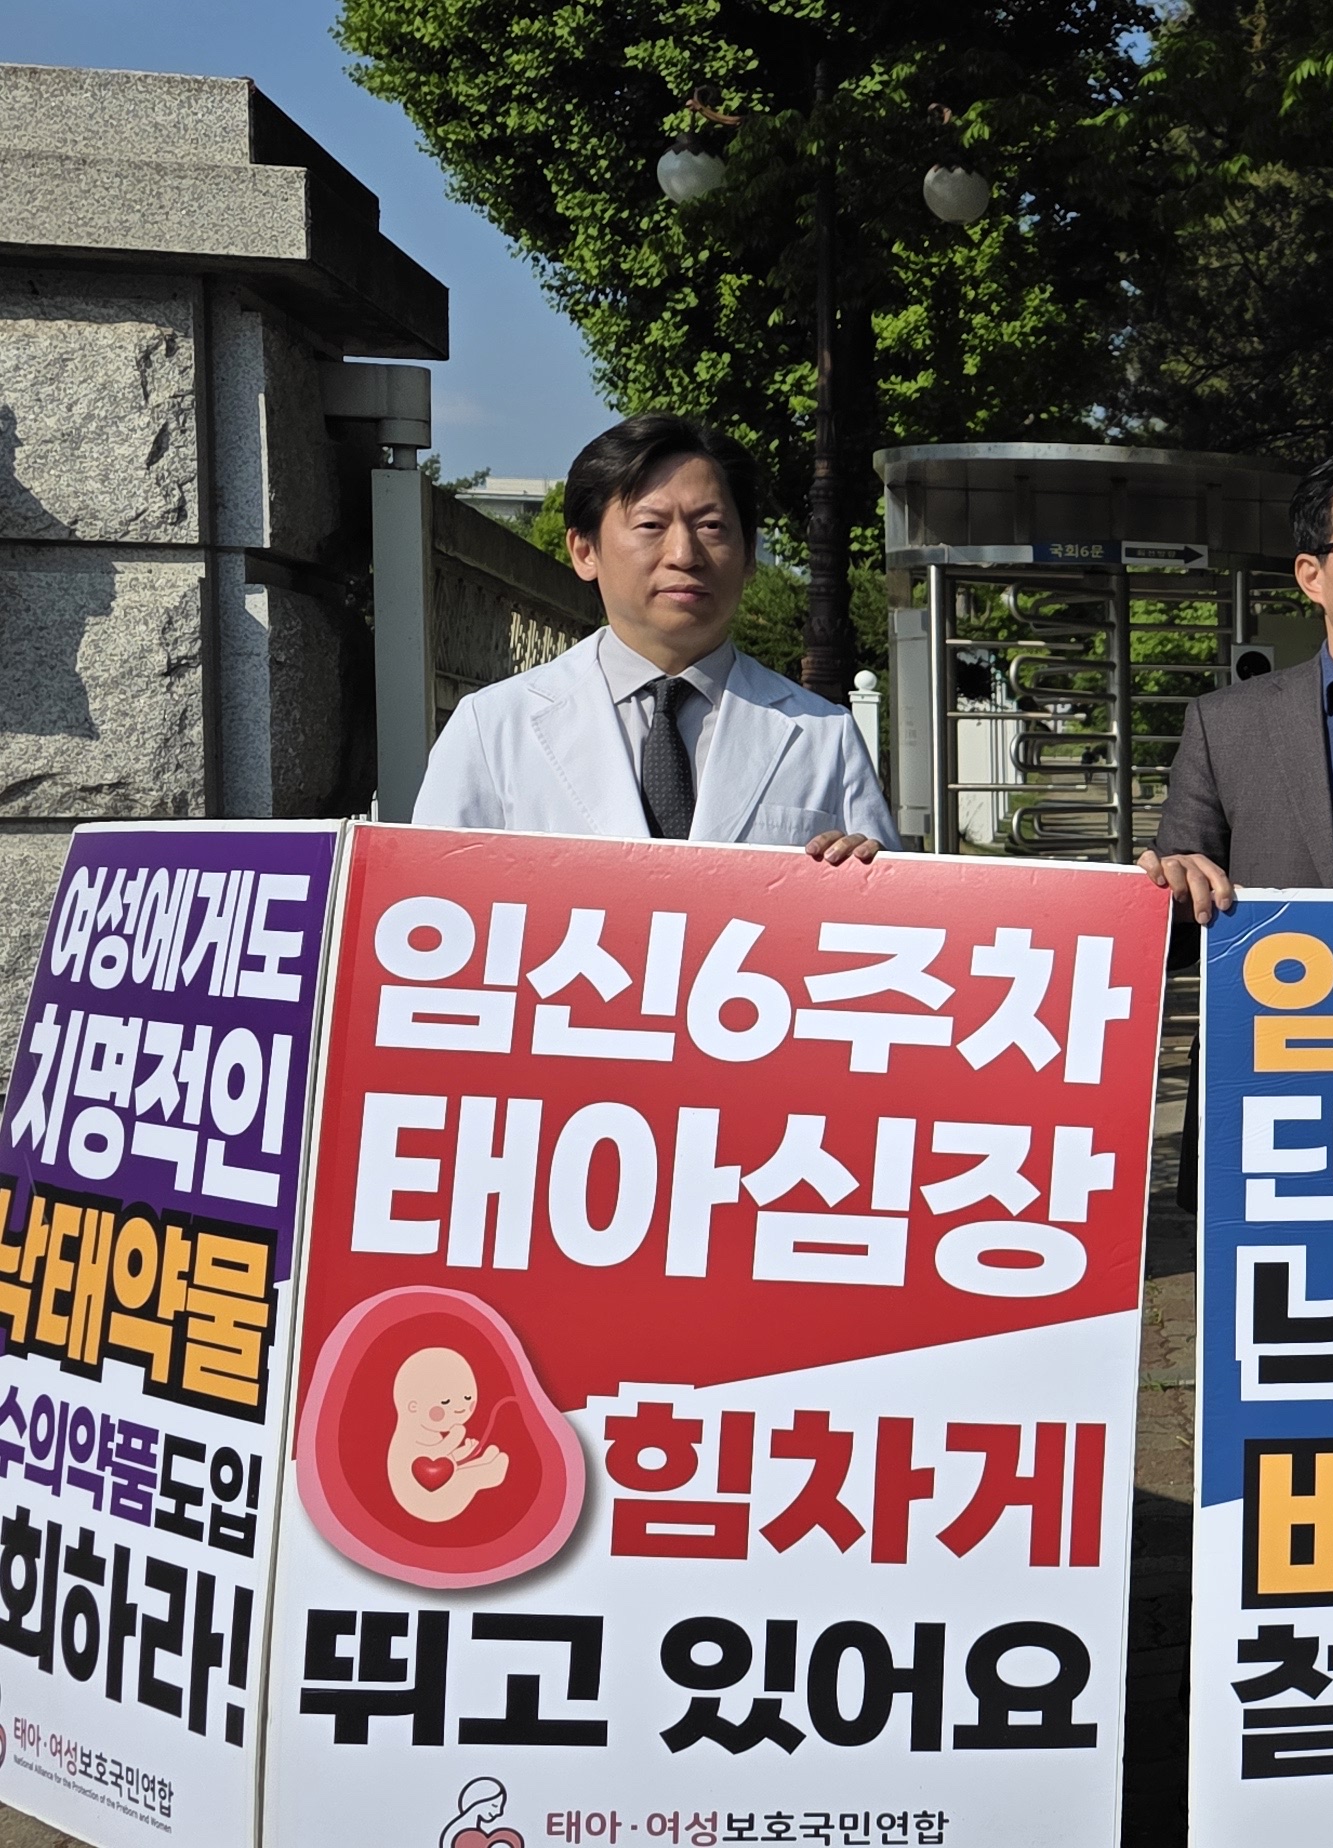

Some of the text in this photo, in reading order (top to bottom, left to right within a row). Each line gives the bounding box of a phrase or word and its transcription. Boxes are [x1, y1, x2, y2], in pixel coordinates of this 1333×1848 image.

[1049, 543, 1105, 559] 국회6문
[50, 864, 311, 1002] 여성에게도
[374, 895, 1132, 1085] 임신6주차
[10, 1001, 293, 1208] 치명적인
[350, 1091, 1116, 1298] 태아심장
[603, 1401, 1107, 1567] 힘차게
[299, 1608, 1099, 1756] 뛰고 있어요
